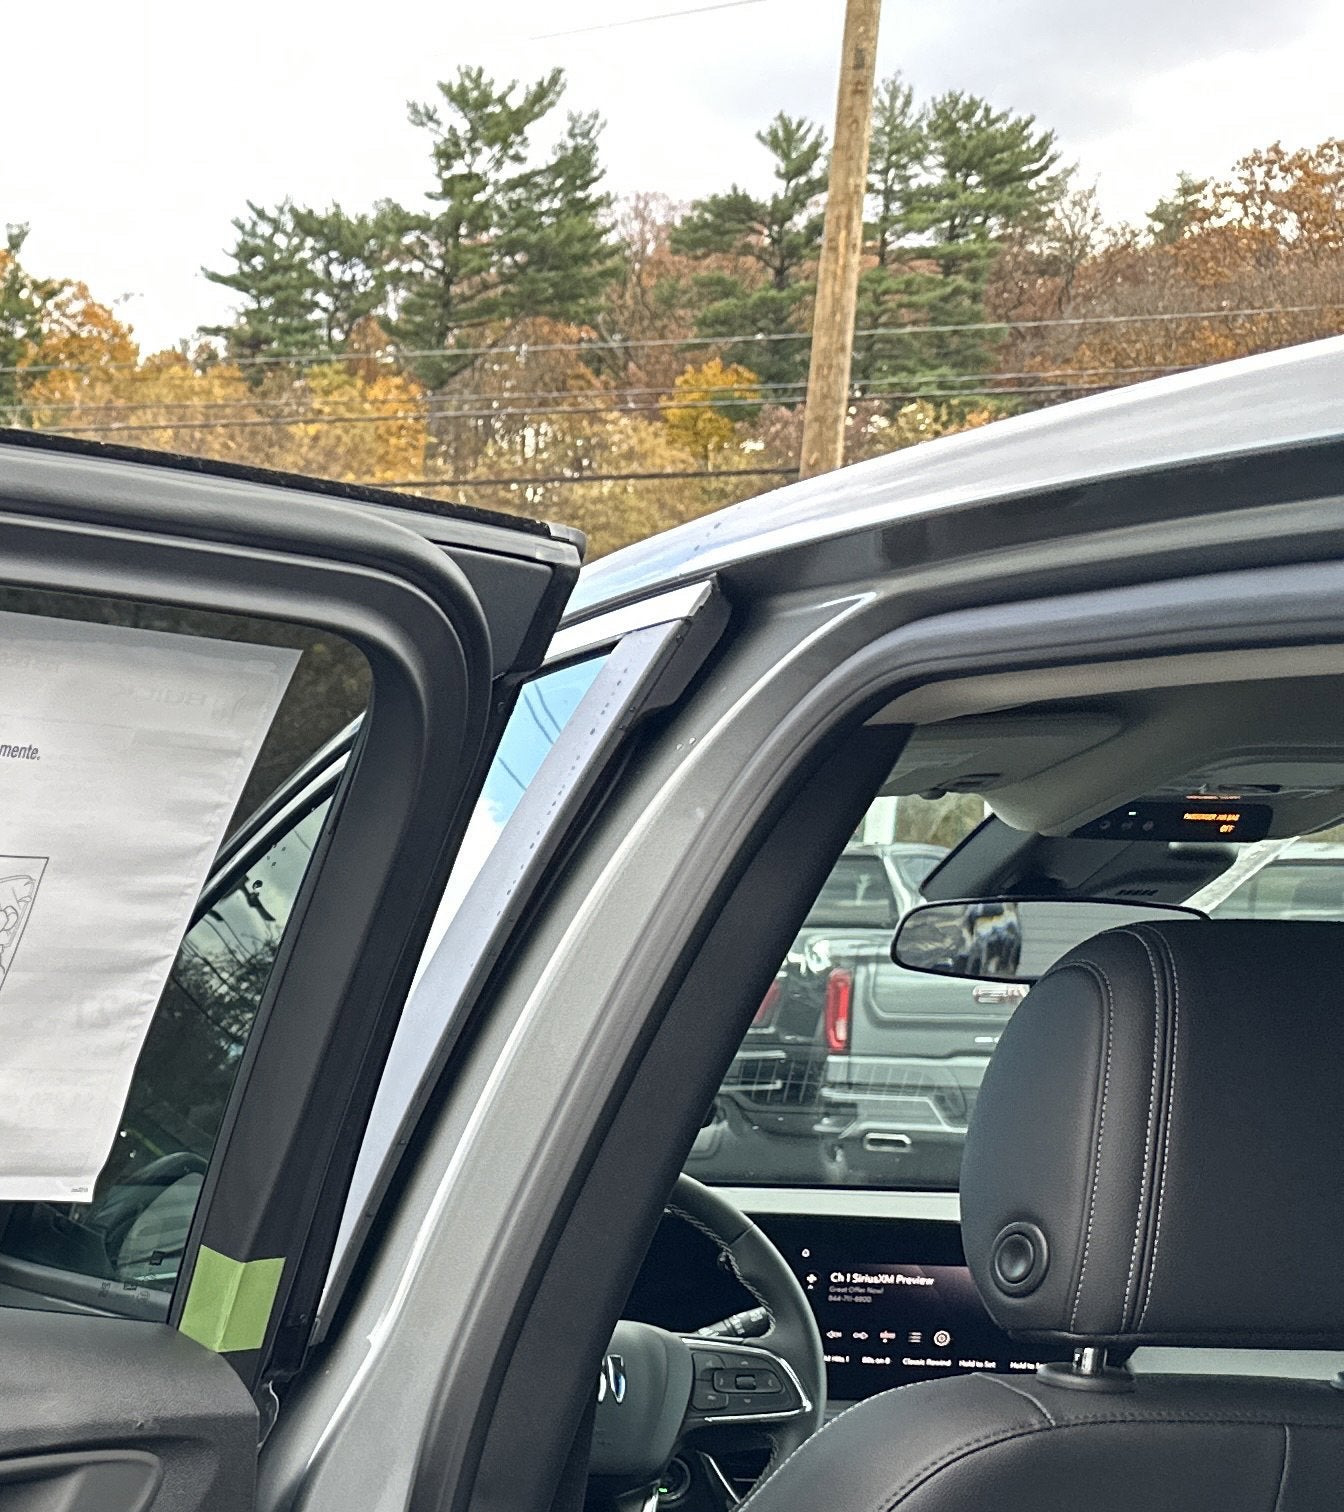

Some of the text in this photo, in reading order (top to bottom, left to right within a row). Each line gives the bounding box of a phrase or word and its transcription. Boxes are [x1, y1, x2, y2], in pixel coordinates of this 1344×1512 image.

[830, 1272, 845, 1283] Ch
[852, 1272, 895, 1284] SiriusXM
[895, 1274, 934, 1286] Preview
